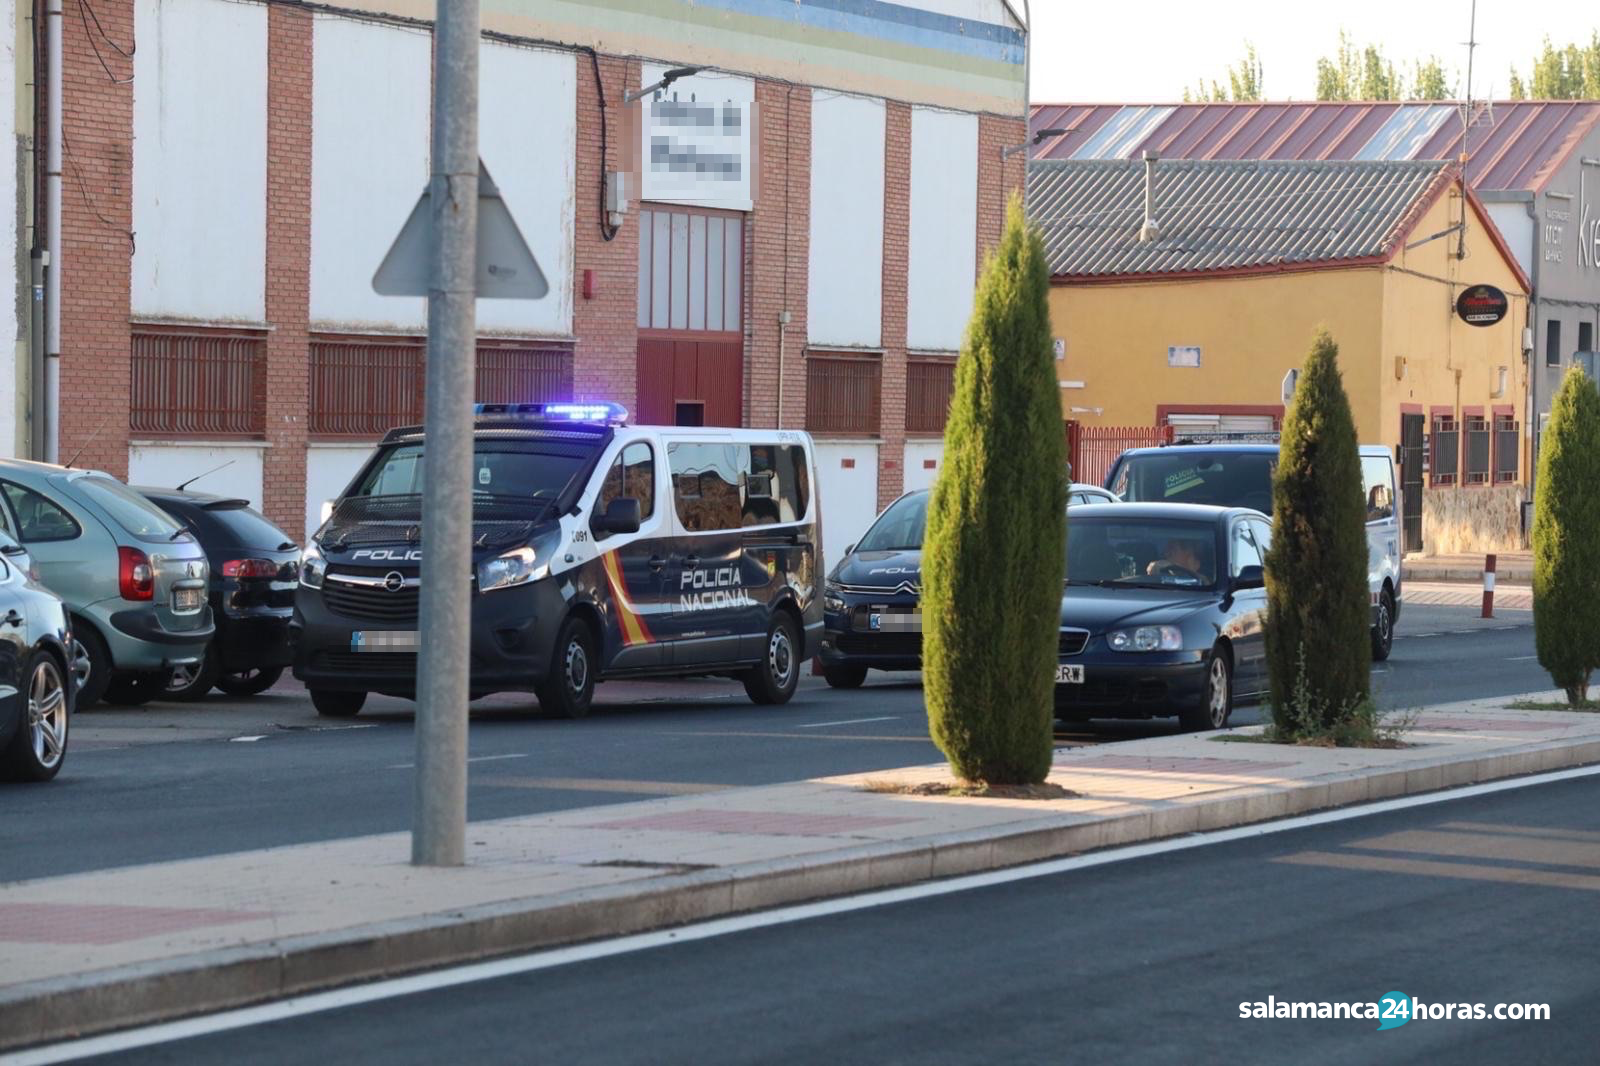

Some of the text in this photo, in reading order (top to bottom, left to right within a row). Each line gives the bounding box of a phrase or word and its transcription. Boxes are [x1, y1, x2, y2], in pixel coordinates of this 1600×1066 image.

[576, 530, 588, 542] 091
[680, 562, 742, 590] POLICÍA
[680, 588, 757, 612] NACIONAL
